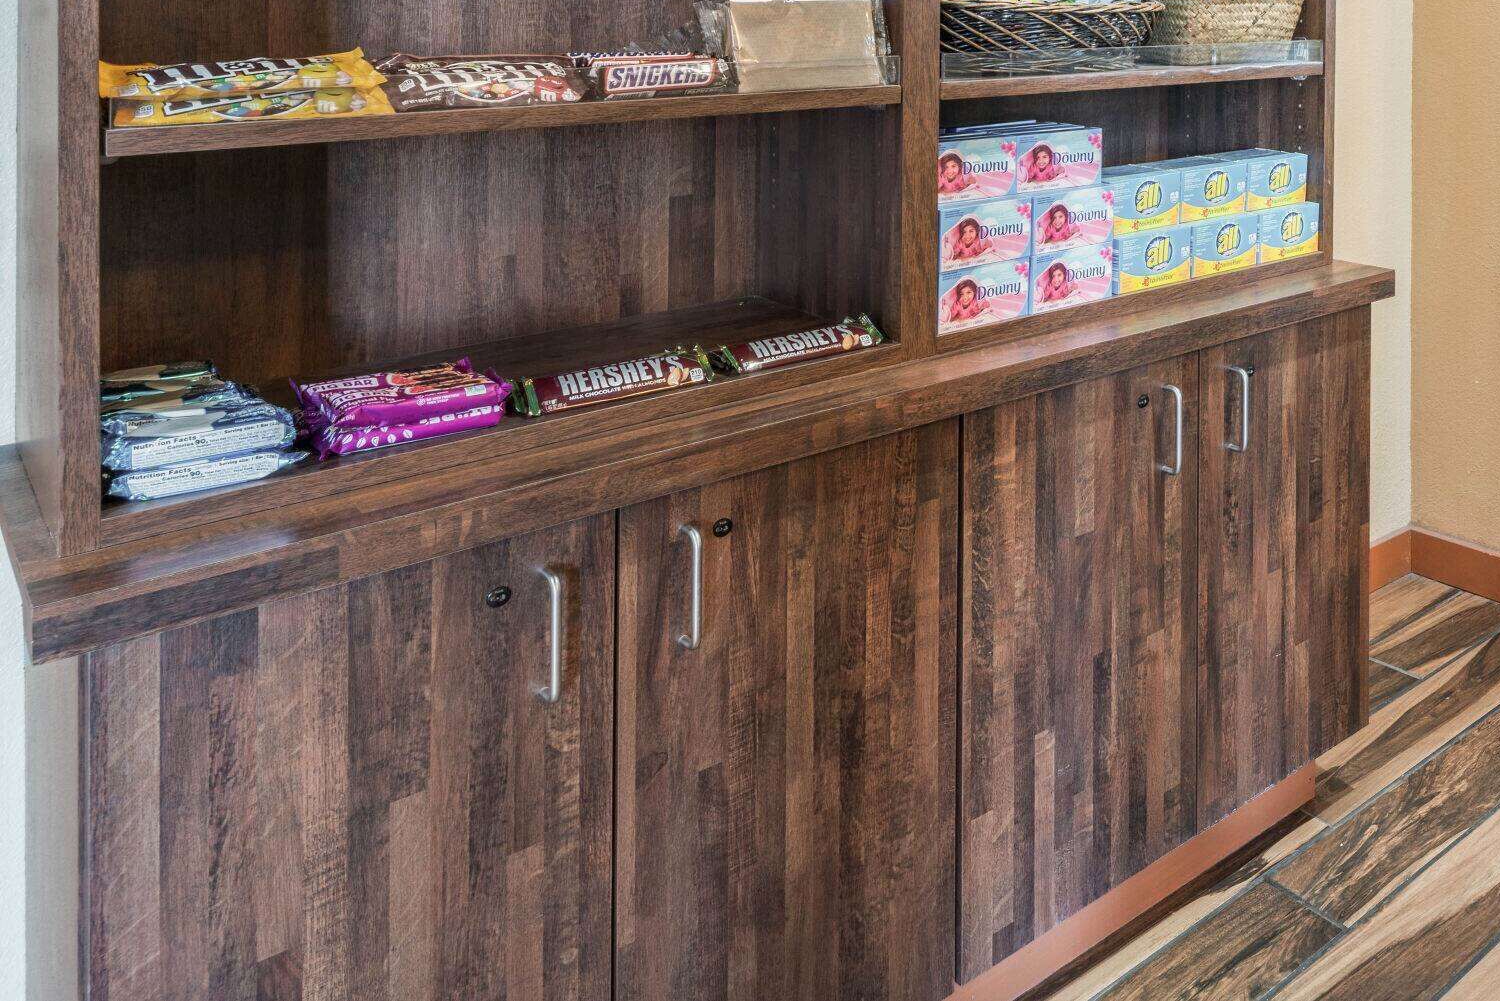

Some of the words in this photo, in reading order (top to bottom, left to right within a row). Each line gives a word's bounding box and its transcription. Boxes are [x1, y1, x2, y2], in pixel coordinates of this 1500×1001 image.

[962, 160, 1009, 175] Downy
[1052, 150, 1094, 166] Downy
[1204, 171, 1228, 201] all
[1270, 163, 1291, 192] all
[1136, 182, 1160, 214] all
[1068, 208, 1108, 225] Downy
[980, 222, 1024, 240] Downy
[1282, 212, 1303, 243] all
[1216, 225, 1240, 256] all
[1145, 237, 1170, 270] all
[1066, 265, 1106, 283] Downy
[977, 281, 1021, 300] Downy
[749, 324, 853, 358] HERSHEY'S
[343, 379, 373, 387] BAR
[558, 355, 685, 396] HERSHEY'S
[584, 387, 621, 398] CHOCOLATE
[128, 471, 166, 481] Nutrition
[168, 467, 191, 476] Facts
